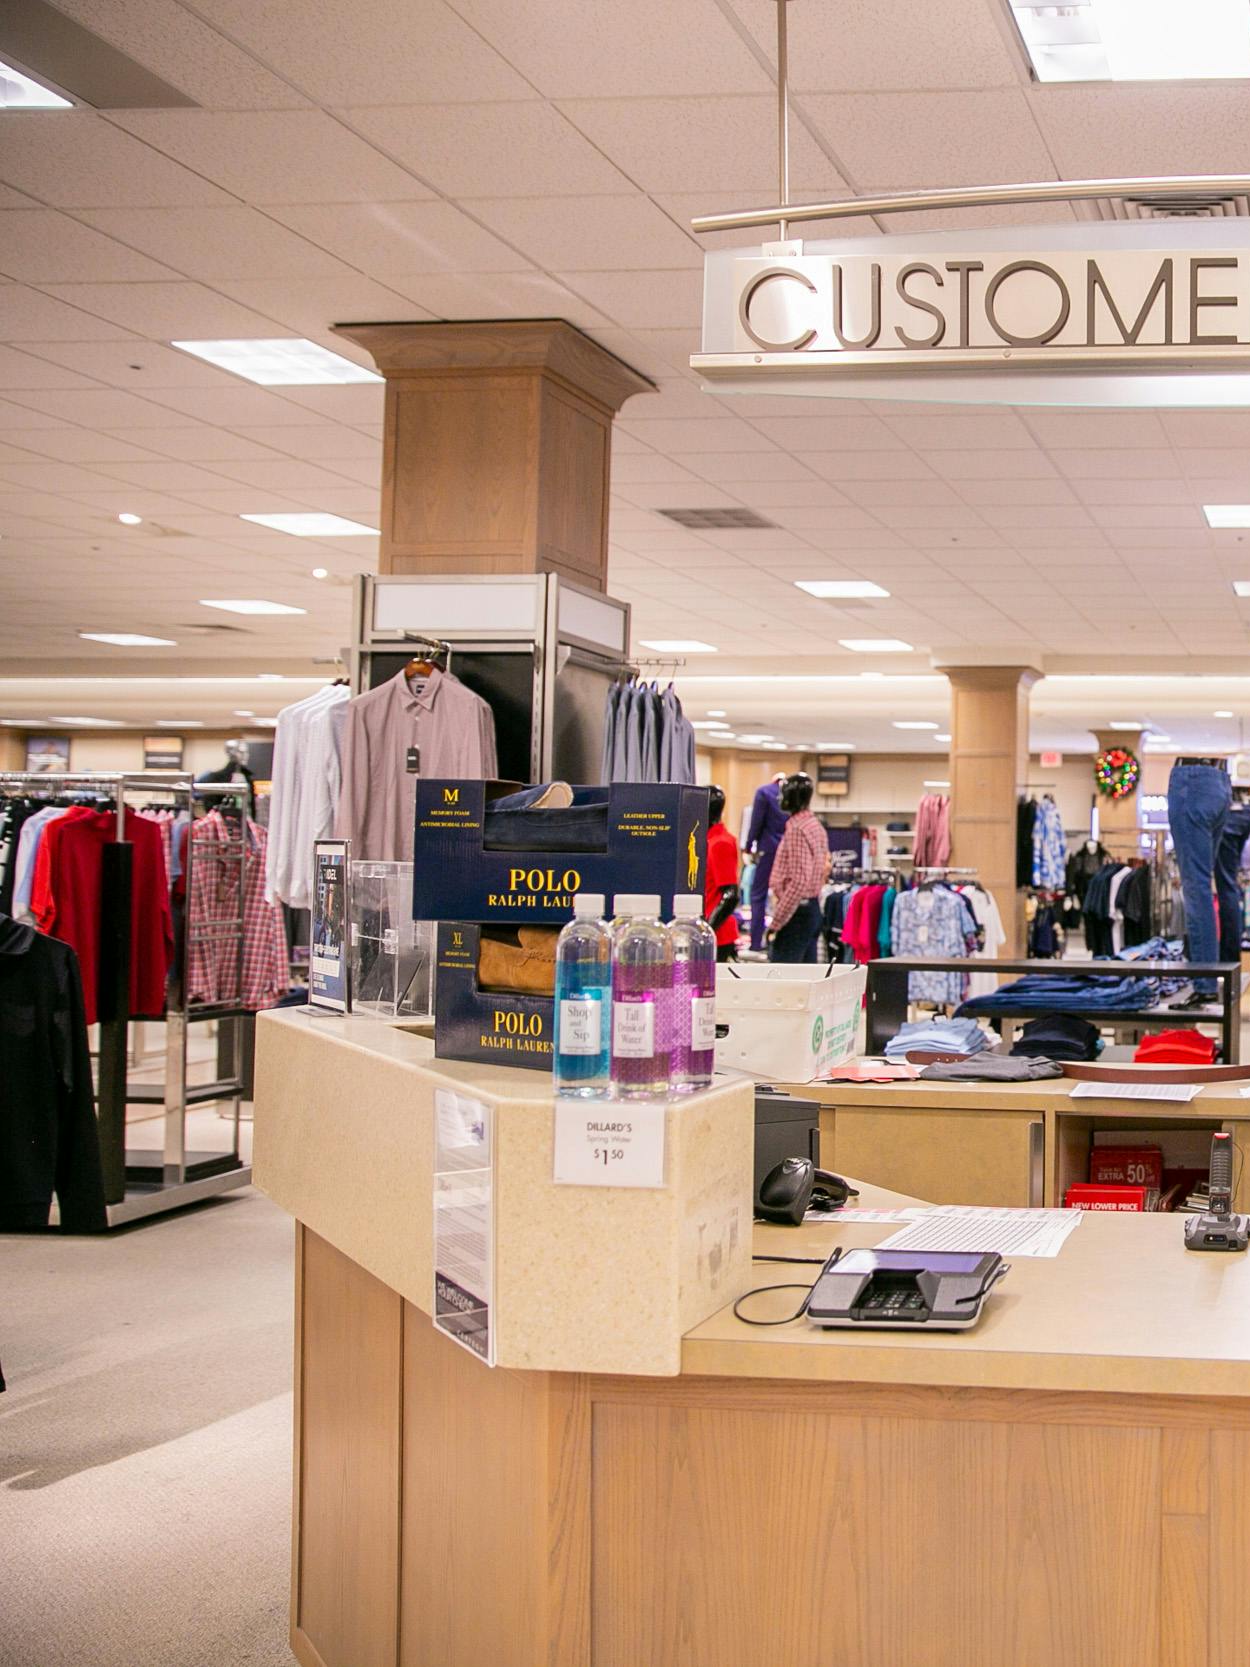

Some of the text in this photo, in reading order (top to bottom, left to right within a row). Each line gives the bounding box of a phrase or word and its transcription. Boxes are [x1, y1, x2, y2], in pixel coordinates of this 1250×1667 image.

[443, 789, 459, 802] M
[510, 869, 581, 892] POLO
[488, 895, 575, 907] RALPH LAU
[453, 931, 463, 945] XL
[568, 1007, 592, 1019] Shop
[624, 1008, 639, 1021] Tall
[494, 1011, 543, 1036] POLO
[480, 1035, 513, 1049] RALPH
[573, 1029, 590, 1042] Sip
[621, 1034, 643, 1044] Water
[586, 1122, 632, 1132] DILLARD'S
[1098, 1172, 1124, 1180] EXTRA
[1071, 1202, 1138, 1211] NEW LOWER PRICE
